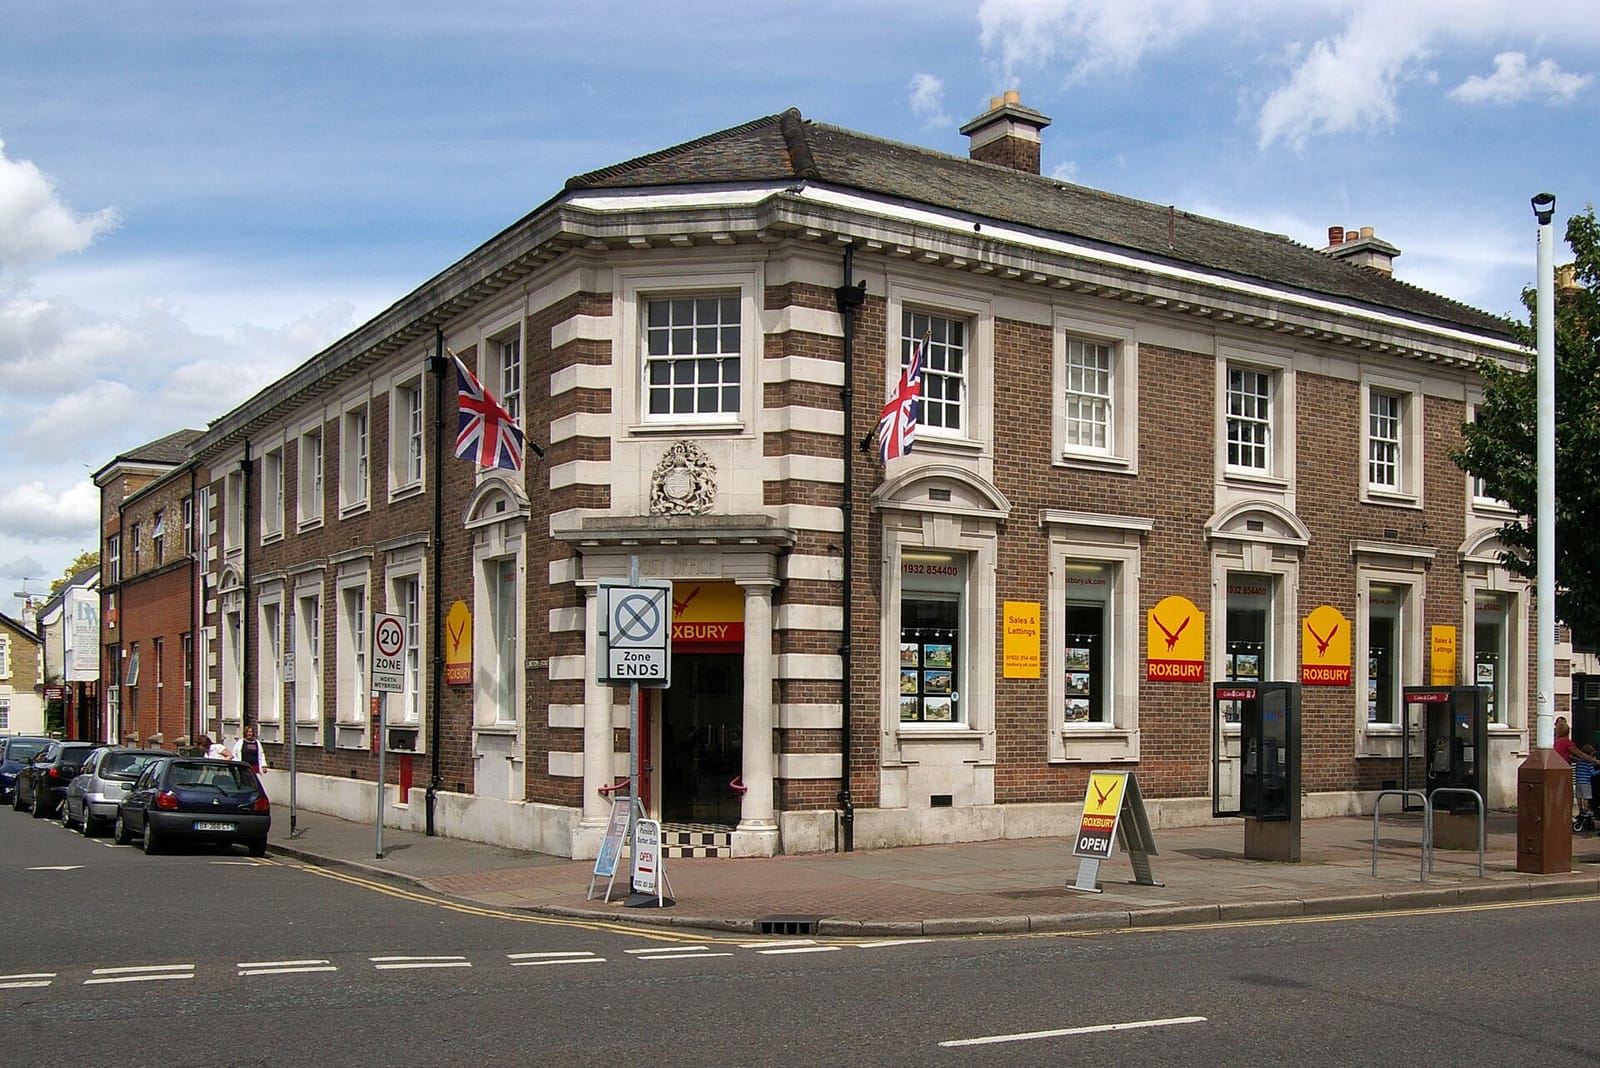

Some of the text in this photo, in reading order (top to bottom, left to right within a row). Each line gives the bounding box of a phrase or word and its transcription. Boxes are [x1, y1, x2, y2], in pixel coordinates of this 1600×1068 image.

[641, 558, 716, 575] OST OFFICE
[902, 564, 958, 576] 1932 854400
[1065, 577, 1106, 586] xbury.uk.com
[1008, 615, 1035, 625] Sales &
[381, 628, 400, 646] 20
[672, 625, 728, 639] XBURY
[1007, 627, 1036, 637] Lettings
[623, 651, 651, 662] Zone
[376, 658, 401, 670] ZONE
[616, 664, 659, 676] ENDS
[447, 667, 470, 680] ROXBURY
[1148, 663, 1203, 678] ROXBURY
[1303, 668, 1349, 681] ROXBURY
[374, 682, 402, 690] WEYBRIDGE
[1083, 817, 1114, 827] ROXBURY
[1080, 837, 1108, 851] OPEN
[640, 852, 653, 862] OPEN
